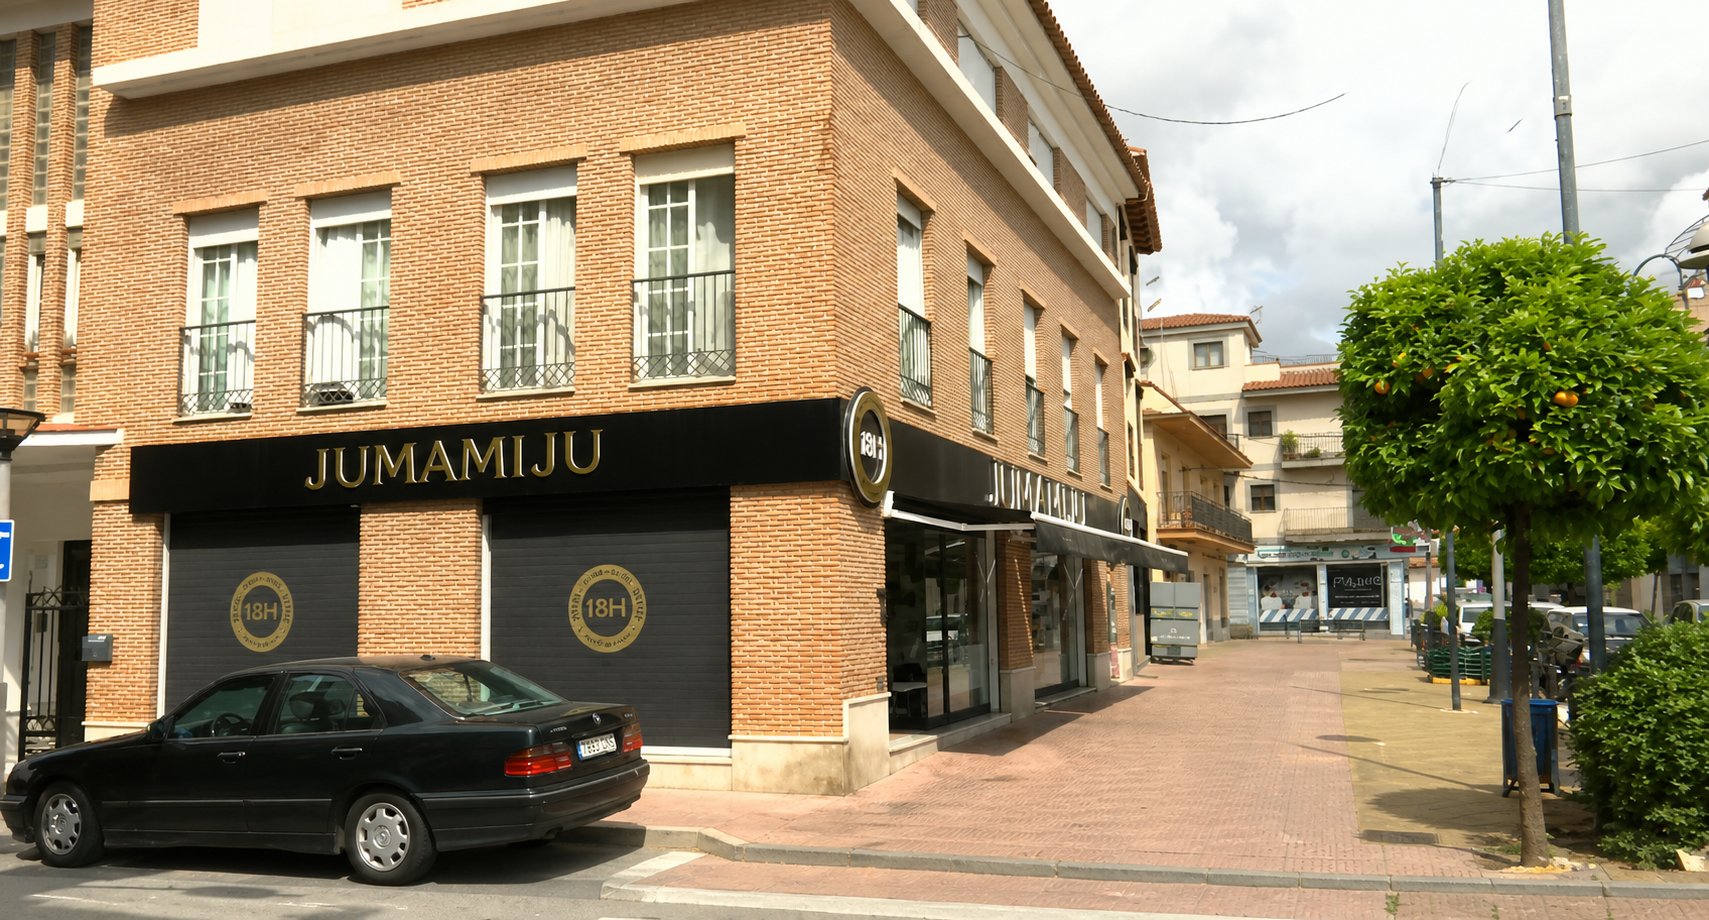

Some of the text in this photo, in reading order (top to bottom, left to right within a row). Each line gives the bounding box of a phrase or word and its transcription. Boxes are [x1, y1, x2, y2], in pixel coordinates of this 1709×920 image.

[304, 429, 603, 490] JUMAMIJU
[244, 602, 278, 620] 18H
[585, 597, 626, 618] 18H
